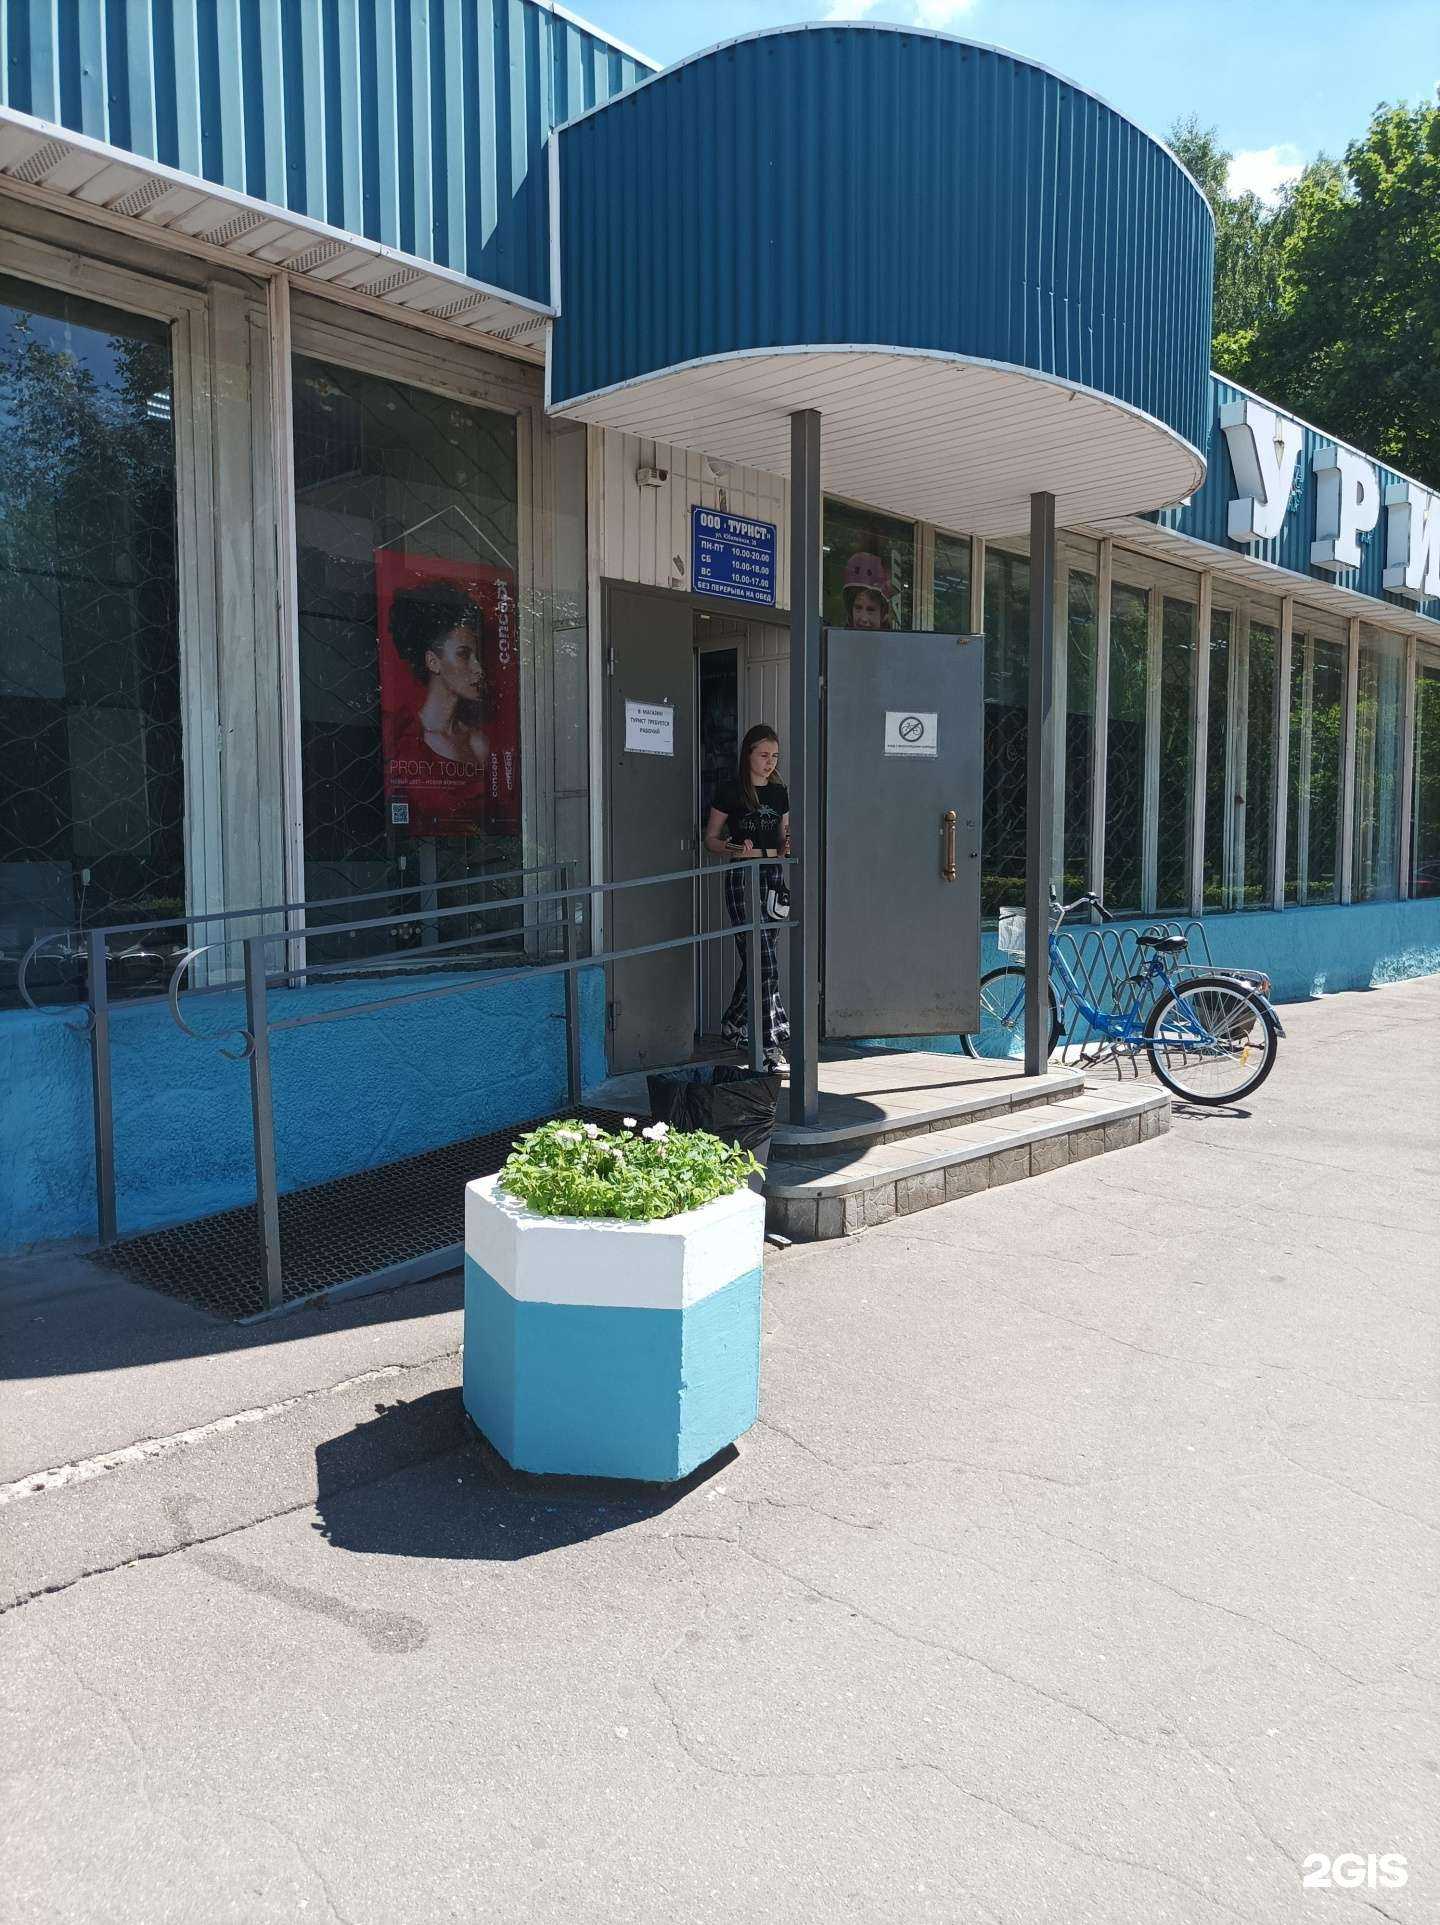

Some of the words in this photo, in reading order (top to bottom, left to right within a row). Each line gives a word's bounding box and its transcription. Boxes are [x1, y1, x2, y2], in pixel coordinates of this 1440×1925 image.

[1181, 399, 1440, 600] УРИ
[700, 513, 720, 530] ООО
[701, 541, 724, 552] ПН-ПТ
[732, 547, 769, 562] 10.00-20.00
[701, 554, 711, 563] СБ
[732, 561, 769, 575] 10.00-18.00
[701, 567, 711, 576] ВС
[731, 574, 769, 588] 10.00-17.00
[697, 581, 710, 590] БЕЗ
[711, 584, 744, 596] ПЕРЕРЫВА
[745, 590, 754, 599] НА
[755, 593, 771, 602] ОБЕД
[390, 760, 434, 776] PROFY
[439, 761, 485, 777] TOUCH
